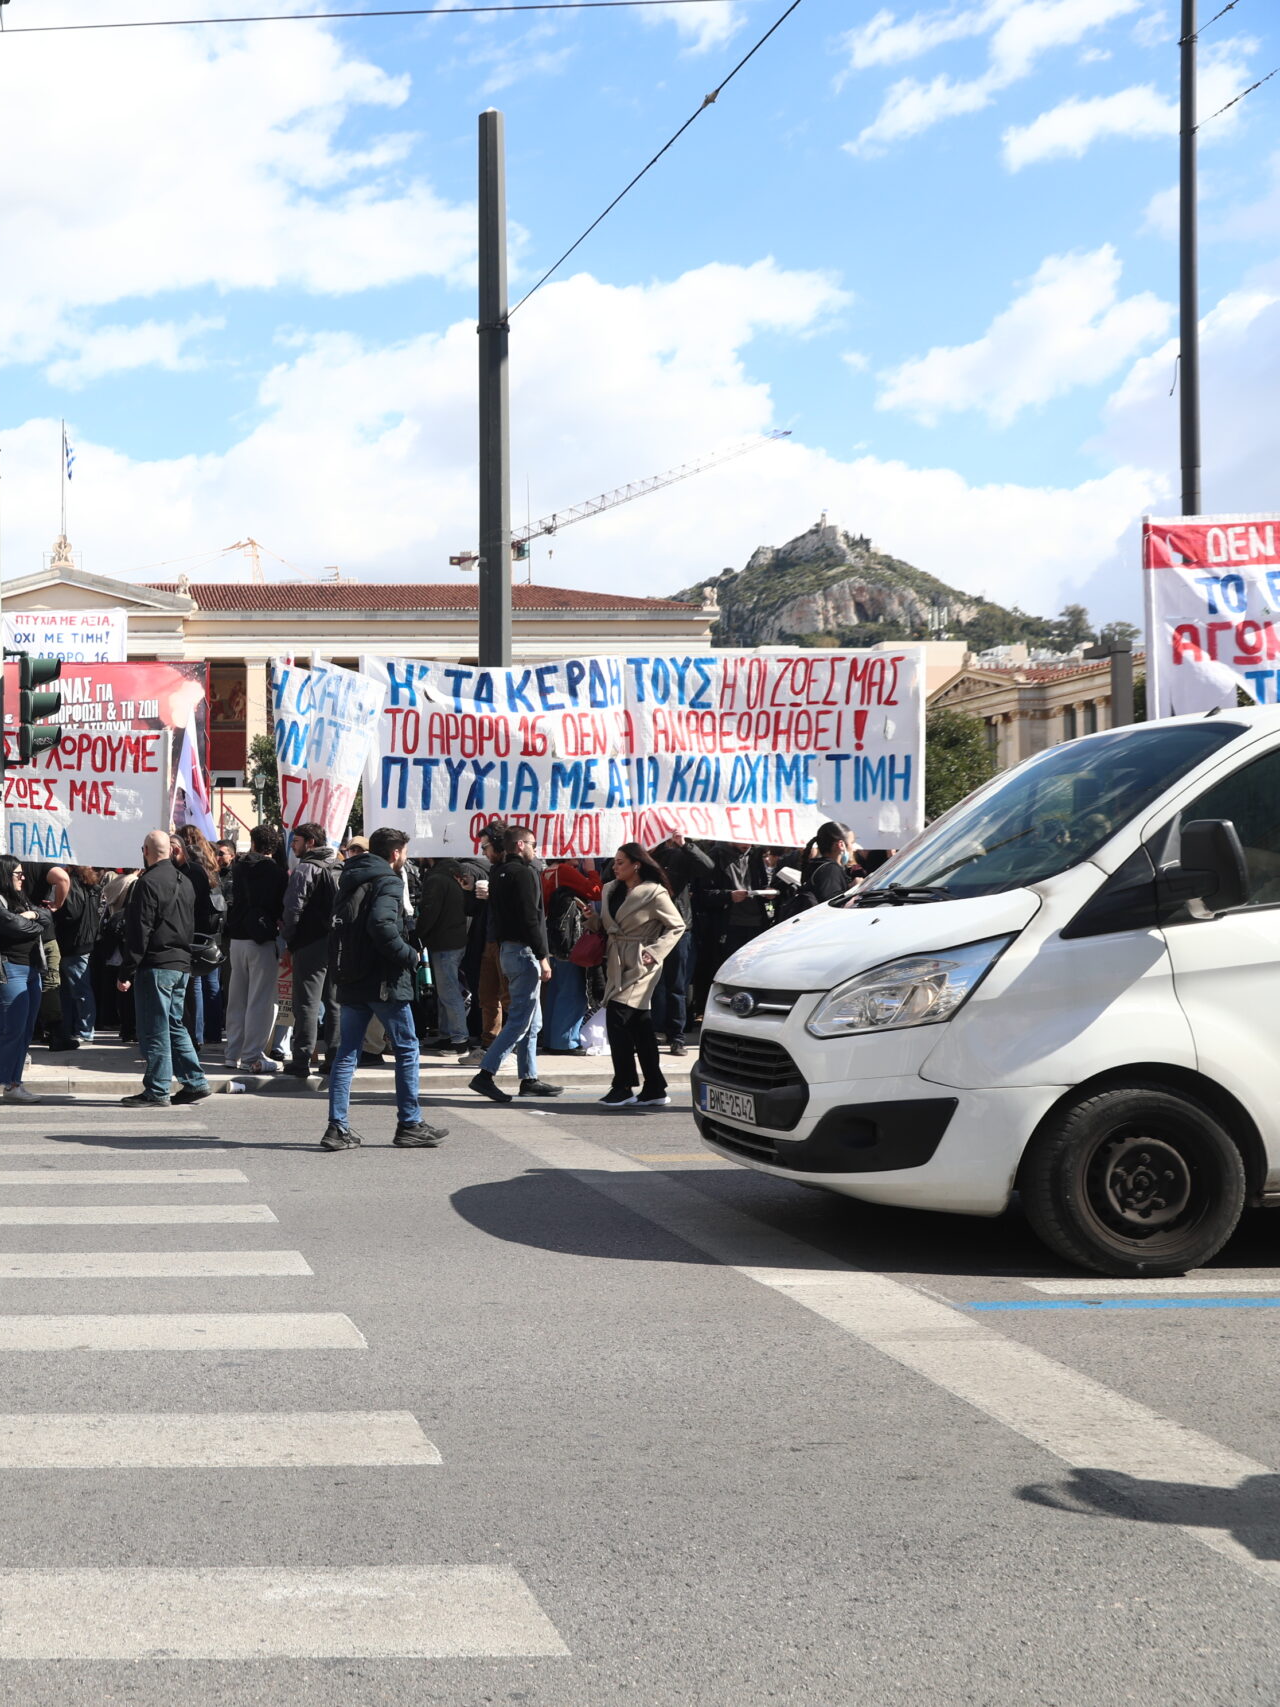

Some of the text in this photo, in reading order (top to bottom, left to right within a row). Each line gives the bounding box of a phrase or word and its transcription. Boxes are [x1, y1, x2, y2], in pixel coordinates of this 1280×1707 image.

[1194, 573, 1247, 614] ΤΟ
[14, 631, 110, 644] ΟΧΙ ΜΕ ΤΙΜΗ!
[15, 615, 57, 625] ΠΤΥΧΙΑ
[60, 616, 77, 626] ΜΕ
[96, 683, 113, 702] ΓΙΑ
[444, 668, 496, 713] ΤΑ
[505, 658, 621, 713] ΚΕΡΔΗ
[626, 656, 718, 709] ΤΟΥΣ
[770, 656, 846, 707] ΖΩΕΣ
[846, 656, 906, 706] ΜΑΣ
[120, 701, 135, 719] ΤΗ
[138, 700, 159, 718] ΖΩΗ
[384, 708, 420, 755] ΤΟ
[428, 711, 511, 758] ΑΡΘΡΟ
[518, 715, 548, 757] 16
[3, 778, 58, 811] ΖΩΕΣ
[70, 779, 116, 816] ΜΑΣ
[381, 756, 540, 812] ΠΤΥΧΙΑ
[549, 758, 599, 810] ΜΕ
[670, 753, 720, 803] ΚΑΙ
[728, 753, 768, 803] ΟΧΙ
[775, 753, 818, 804] ΜΕ
[825, 753, 912, 802] ΤΙΜΗ
[9, 822, 72, 858] ΠΑΔΑ
